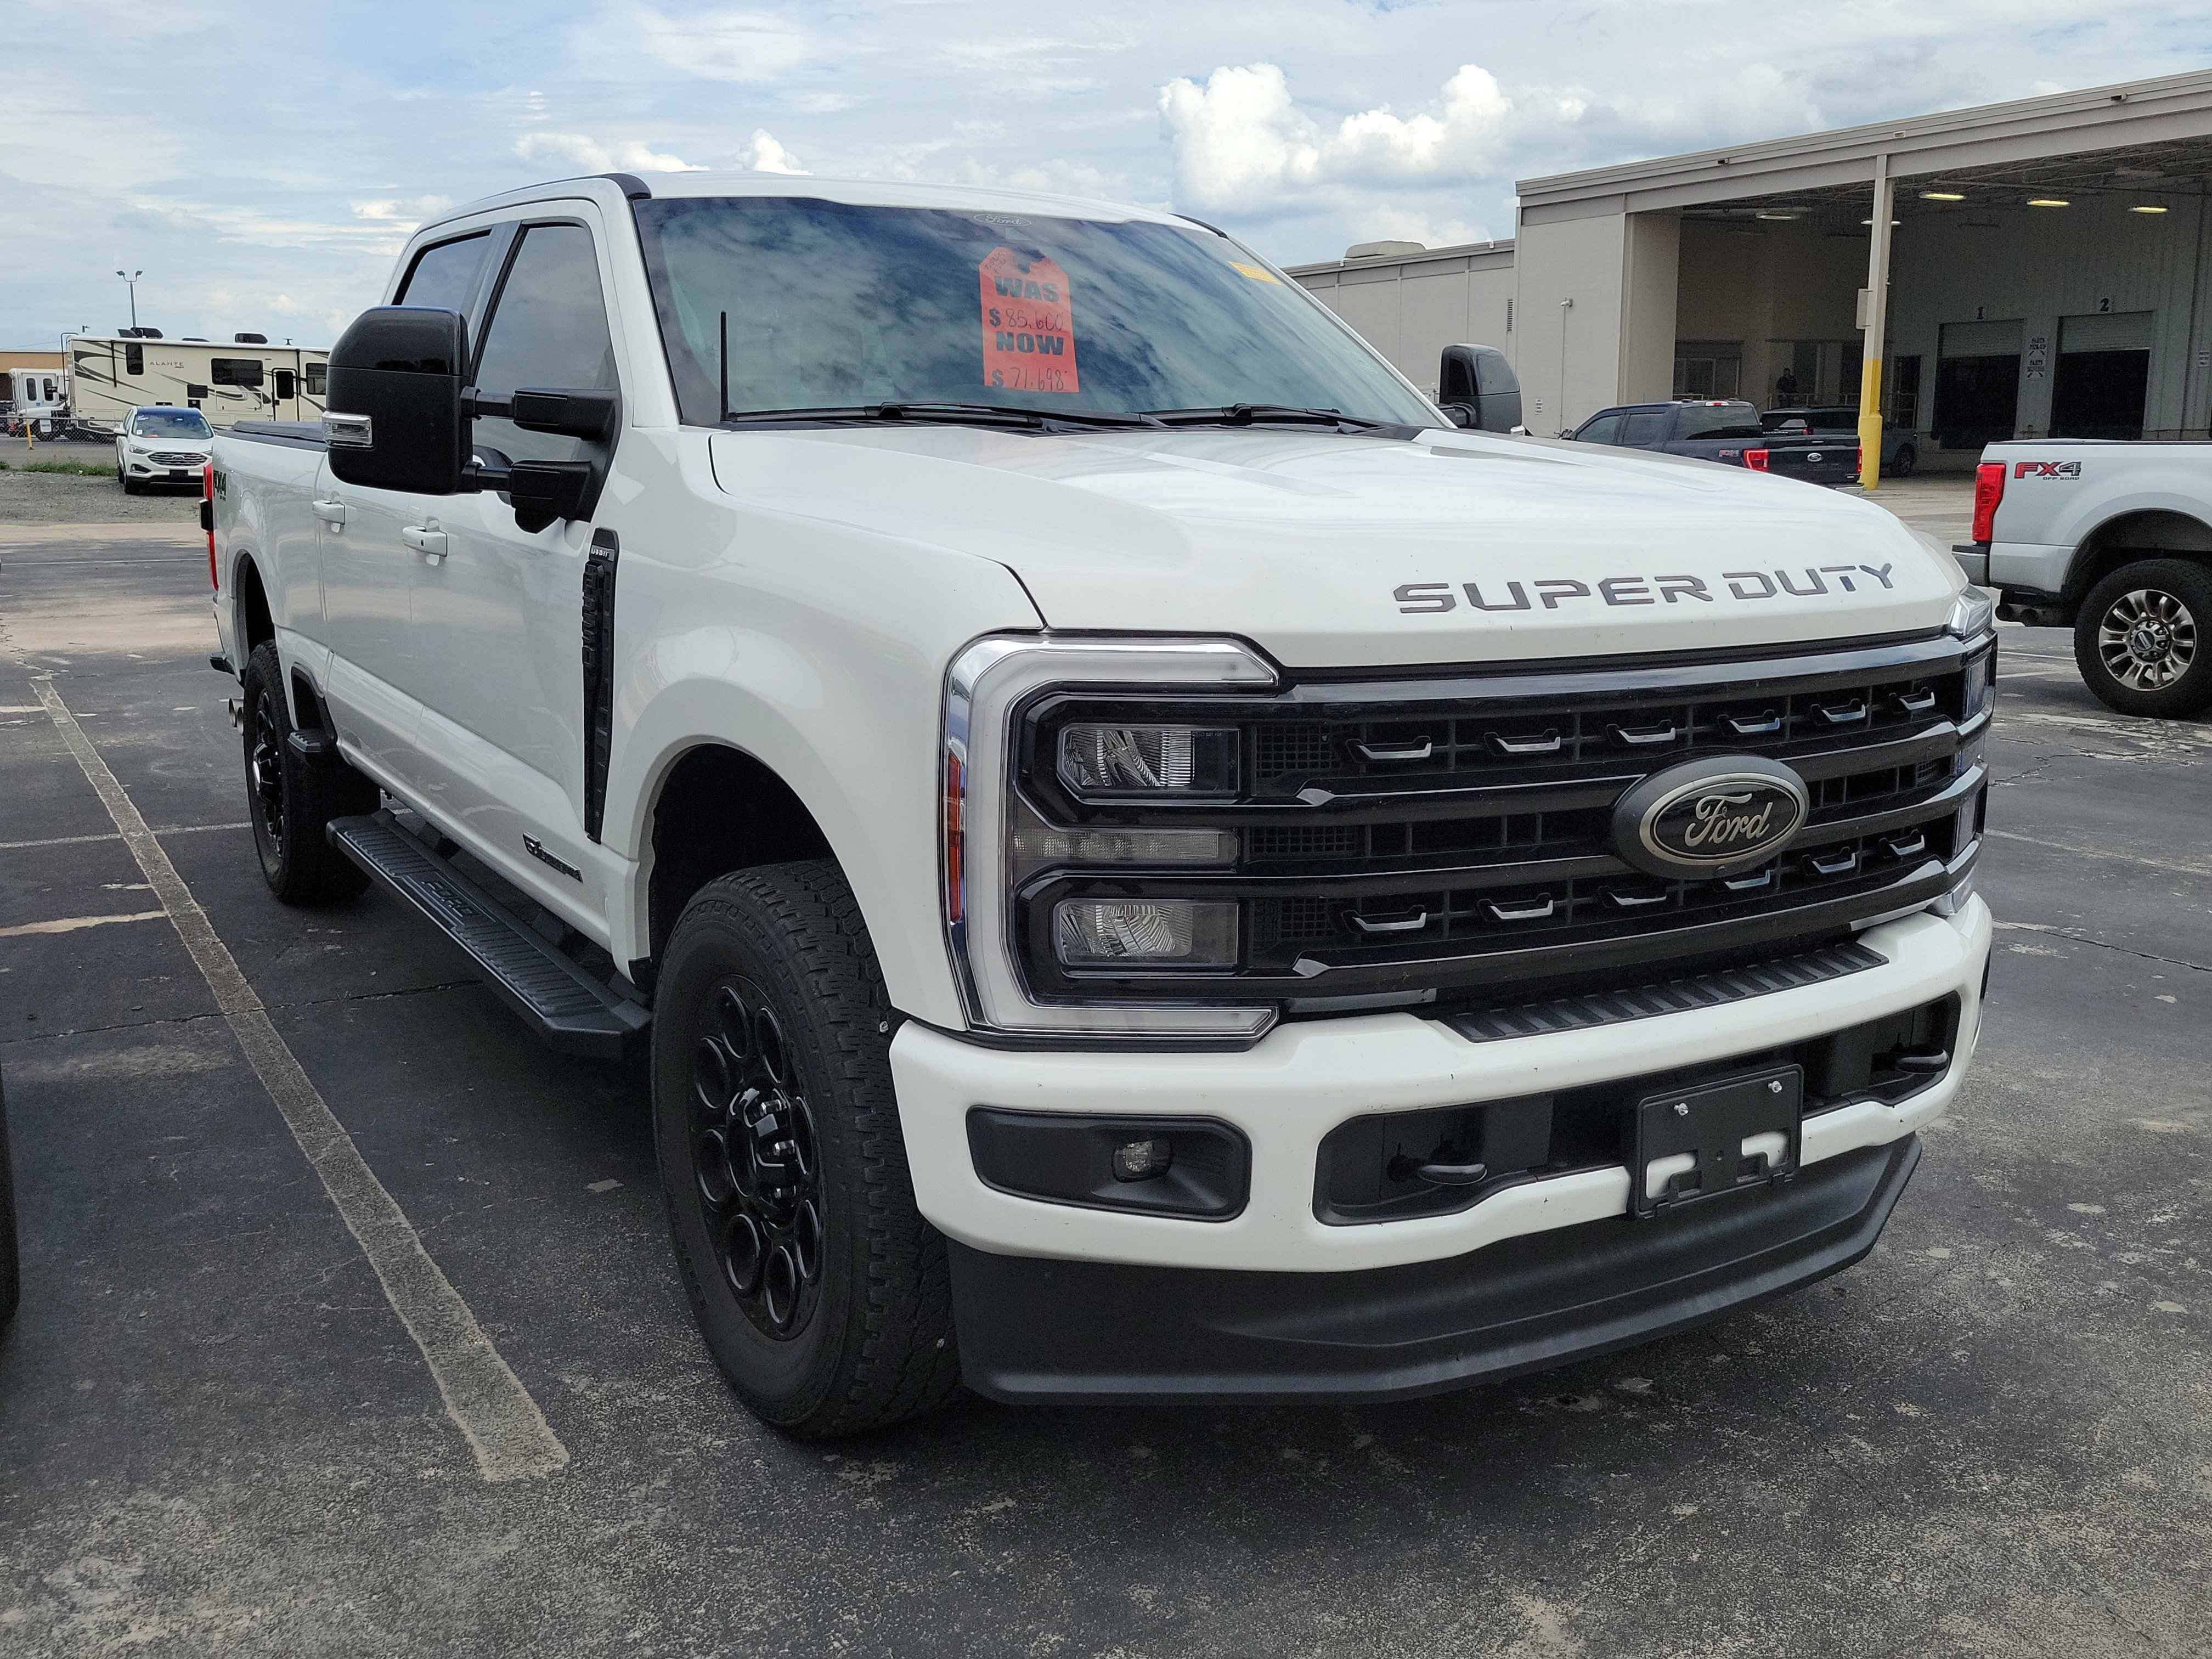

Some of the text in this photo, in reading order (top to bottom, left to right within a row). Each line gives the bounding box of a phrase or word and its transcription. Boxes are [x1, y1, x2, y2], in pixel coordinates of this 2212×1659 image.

[994, 276, 1059, 302] WAS
[2100, 297, 2109, 312] 2
[996, 331, 1064, 356] NOW
[2014, 461, 2082, 479] FX4
[1392, 562, 1894, 614] SUPER DUTY
[1684, 793, 1774, 847] Ford
[421, 879, 478, 918] FORD
